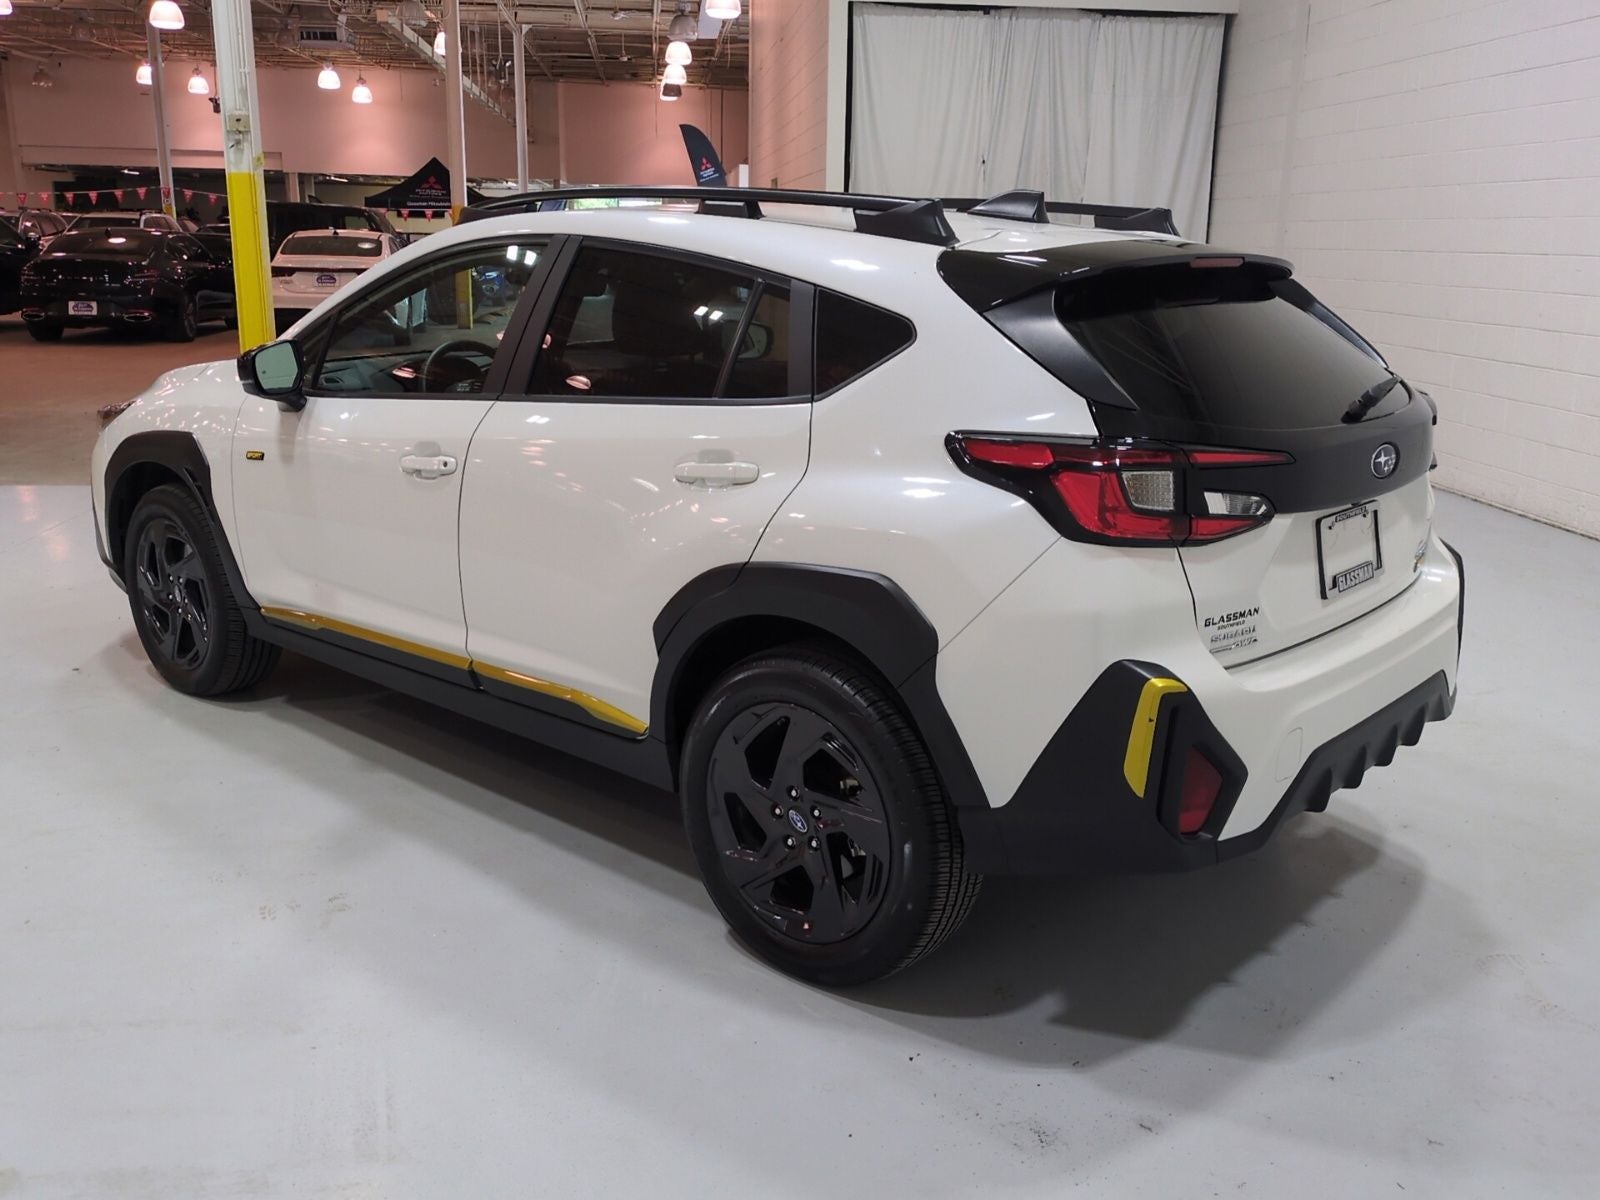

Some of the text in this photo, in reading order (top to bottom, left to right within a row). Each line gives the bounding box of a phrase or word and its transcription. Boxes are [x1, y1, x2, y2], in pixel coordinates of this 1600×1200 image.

[1338, 562, 1373, 591] GLASSMAN
[1204, 606, 1260, 628] GLASSMAN
[1217, 619, 1246, 631] SOUTHFIELD
